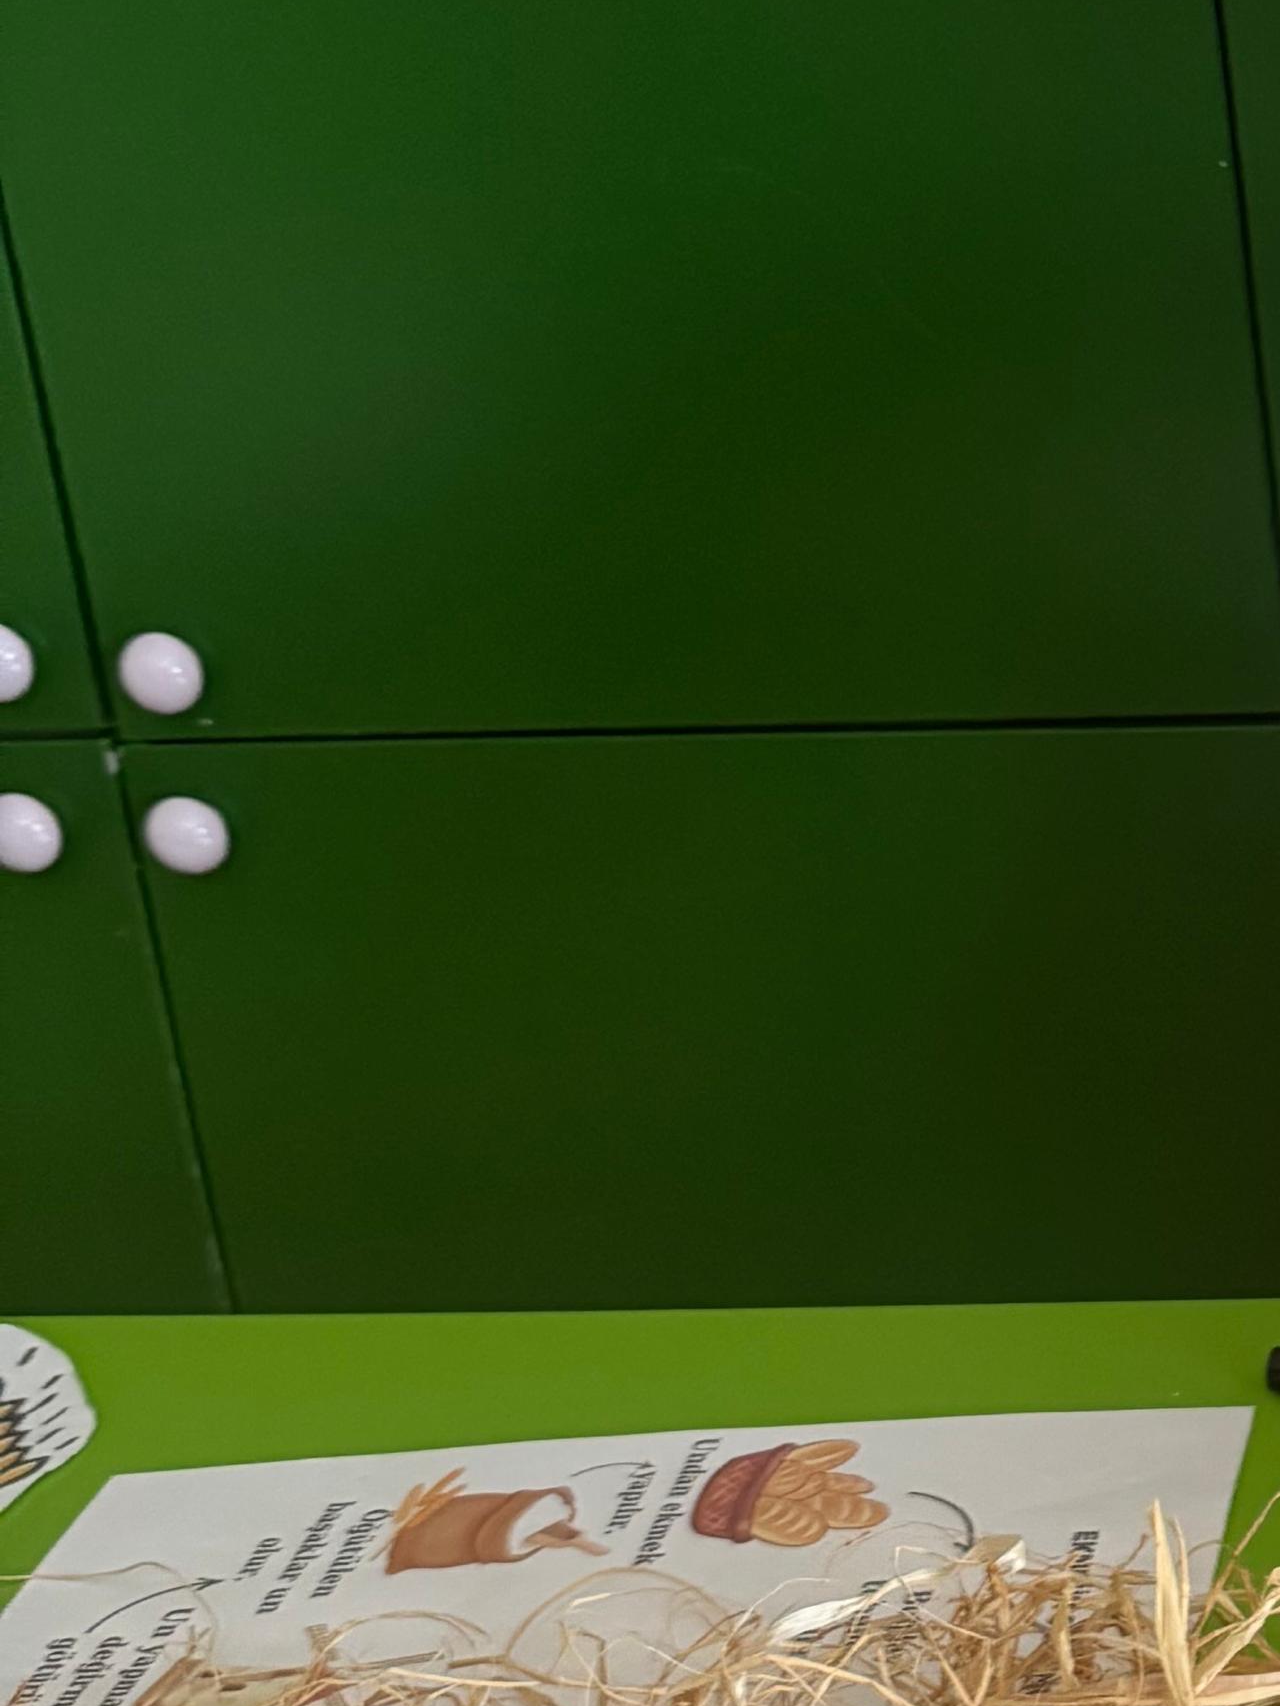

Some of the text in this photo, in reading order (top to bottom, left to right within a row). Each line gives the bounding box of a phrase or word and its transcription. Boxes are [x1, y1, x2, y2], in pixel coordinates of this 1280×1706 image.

[633, 1438, 724, 1566] Undan ekmek
[256, 1586, 294, 1614] un
[150, 1607, 198, 1638] Un
